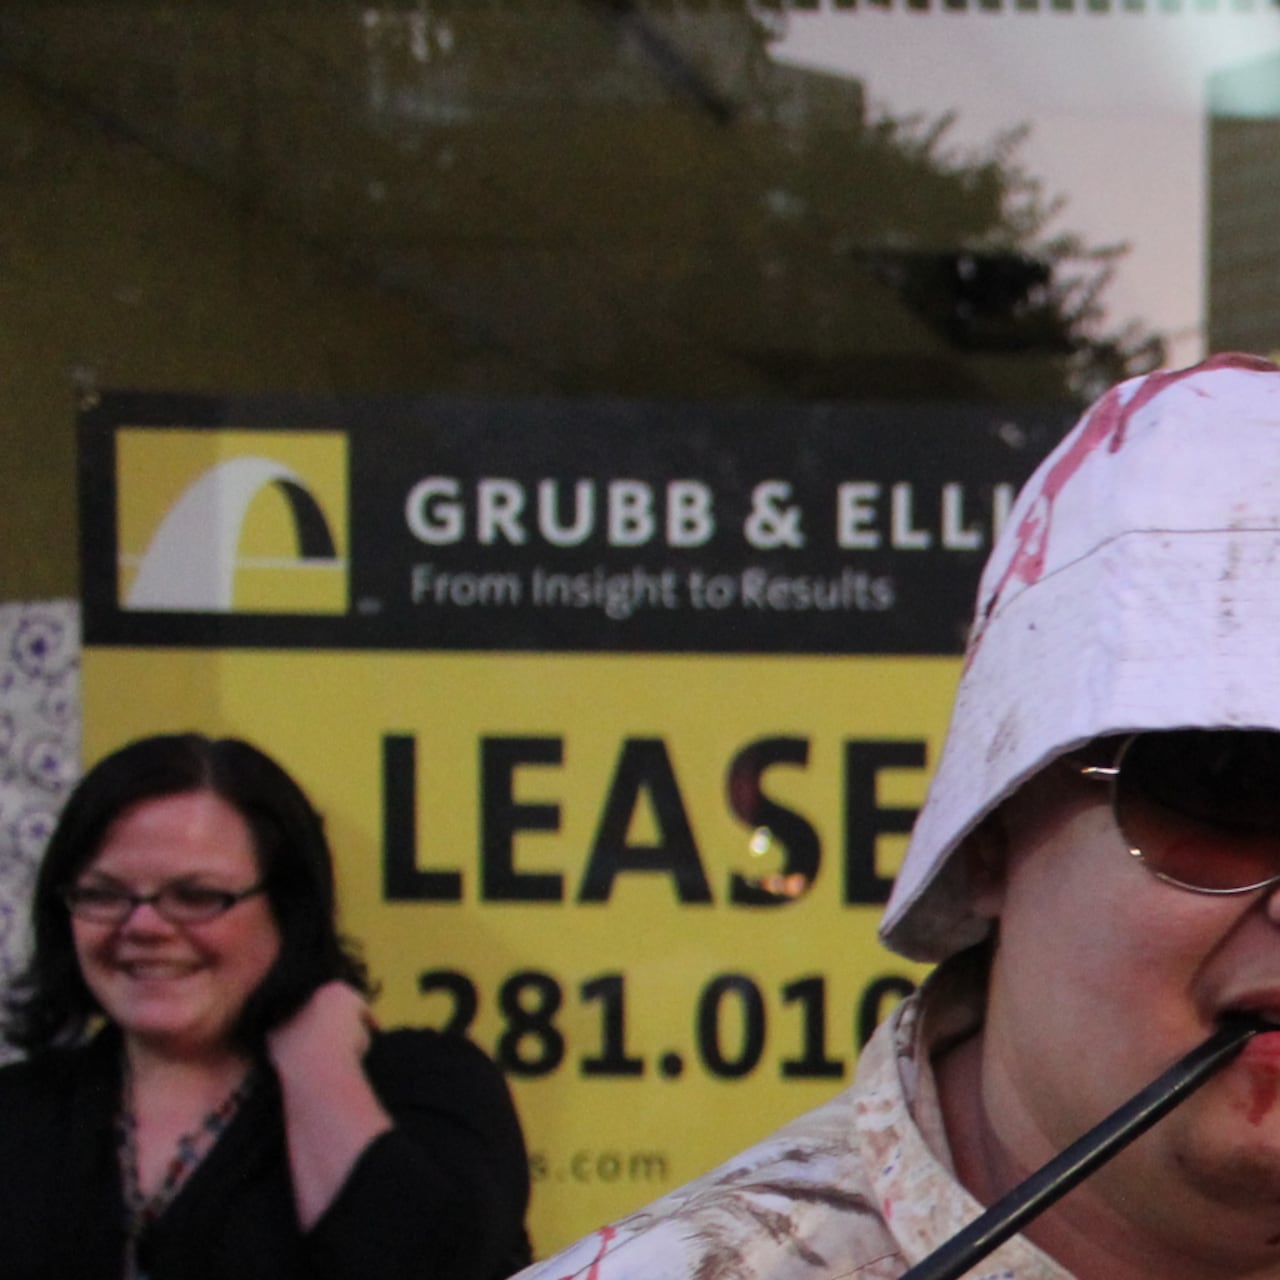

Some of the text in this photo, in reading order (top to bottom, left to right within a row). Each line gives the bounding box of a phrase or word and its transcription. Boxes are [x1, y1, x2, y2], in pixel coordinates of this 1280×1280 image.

[404, 475, 714, 547] GRUBB
[743, 479, 805, 549] &
[410, 562, 894, 621] From Insight to Results
[380, 732, 928, 909] LEASE
